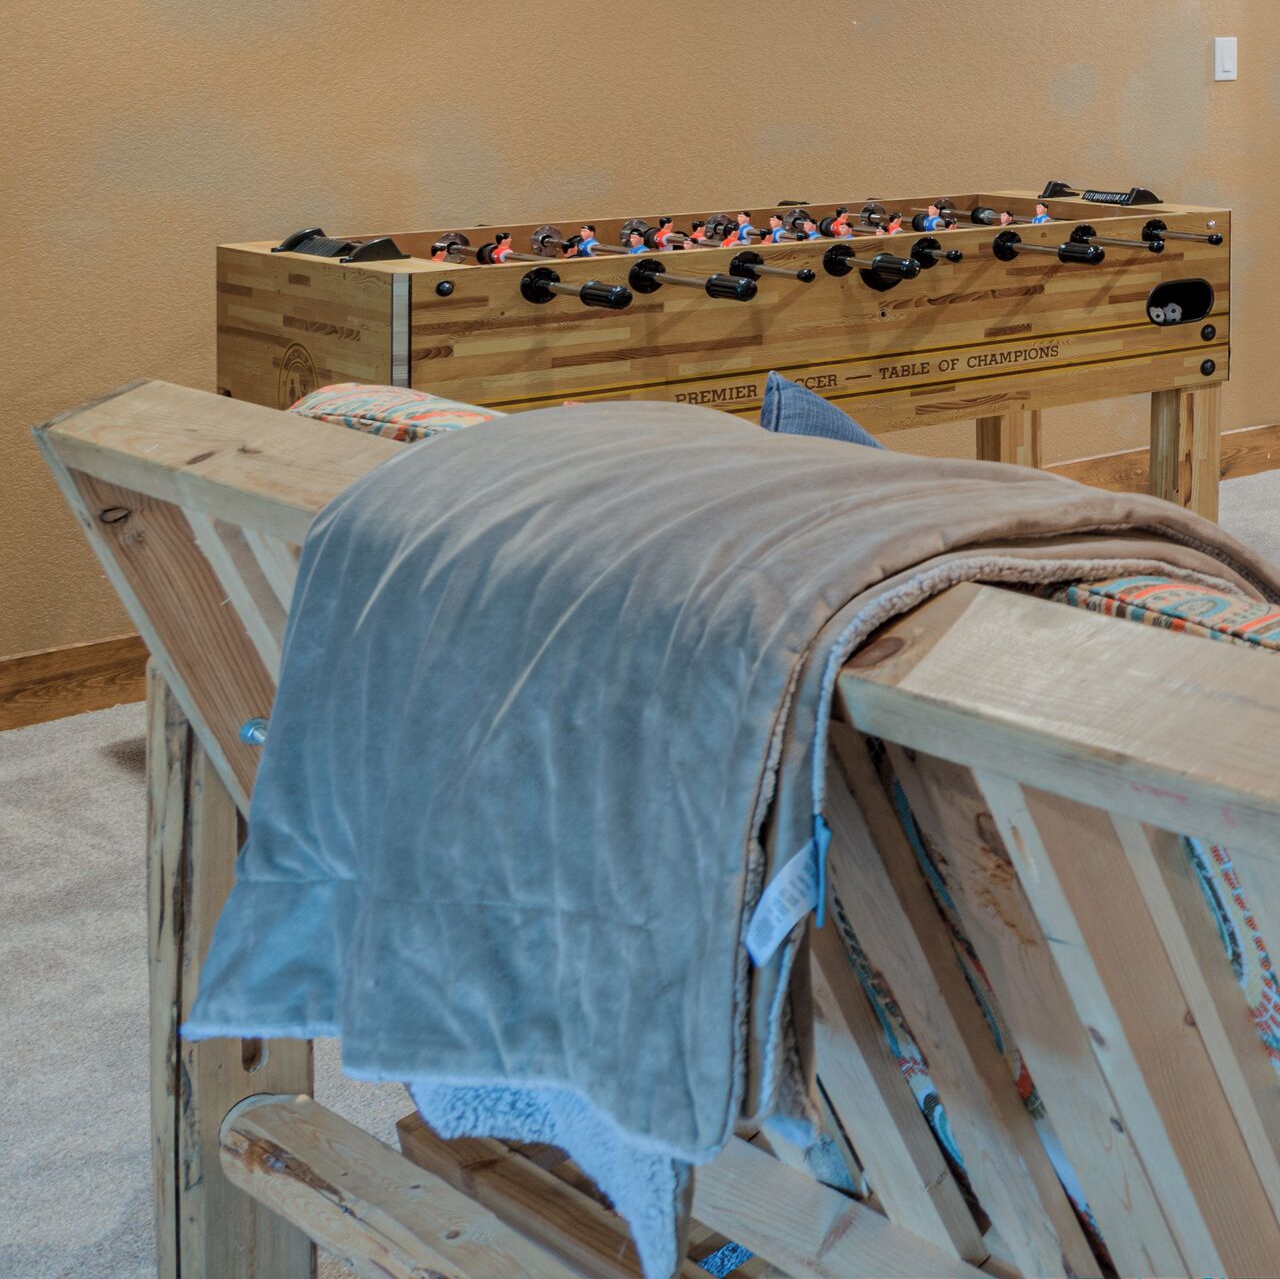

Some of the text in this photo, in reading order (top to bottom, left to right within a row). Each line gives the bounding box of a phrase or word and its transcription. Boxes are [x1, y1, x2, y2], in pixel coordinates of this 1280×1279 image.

[674, 384, 758, 405] PREMIER
[878, 362, 930, 380] TABLE
[937, 358, 960, 372] OF
[966, 345, 1060, 369] CHAMPIONS
